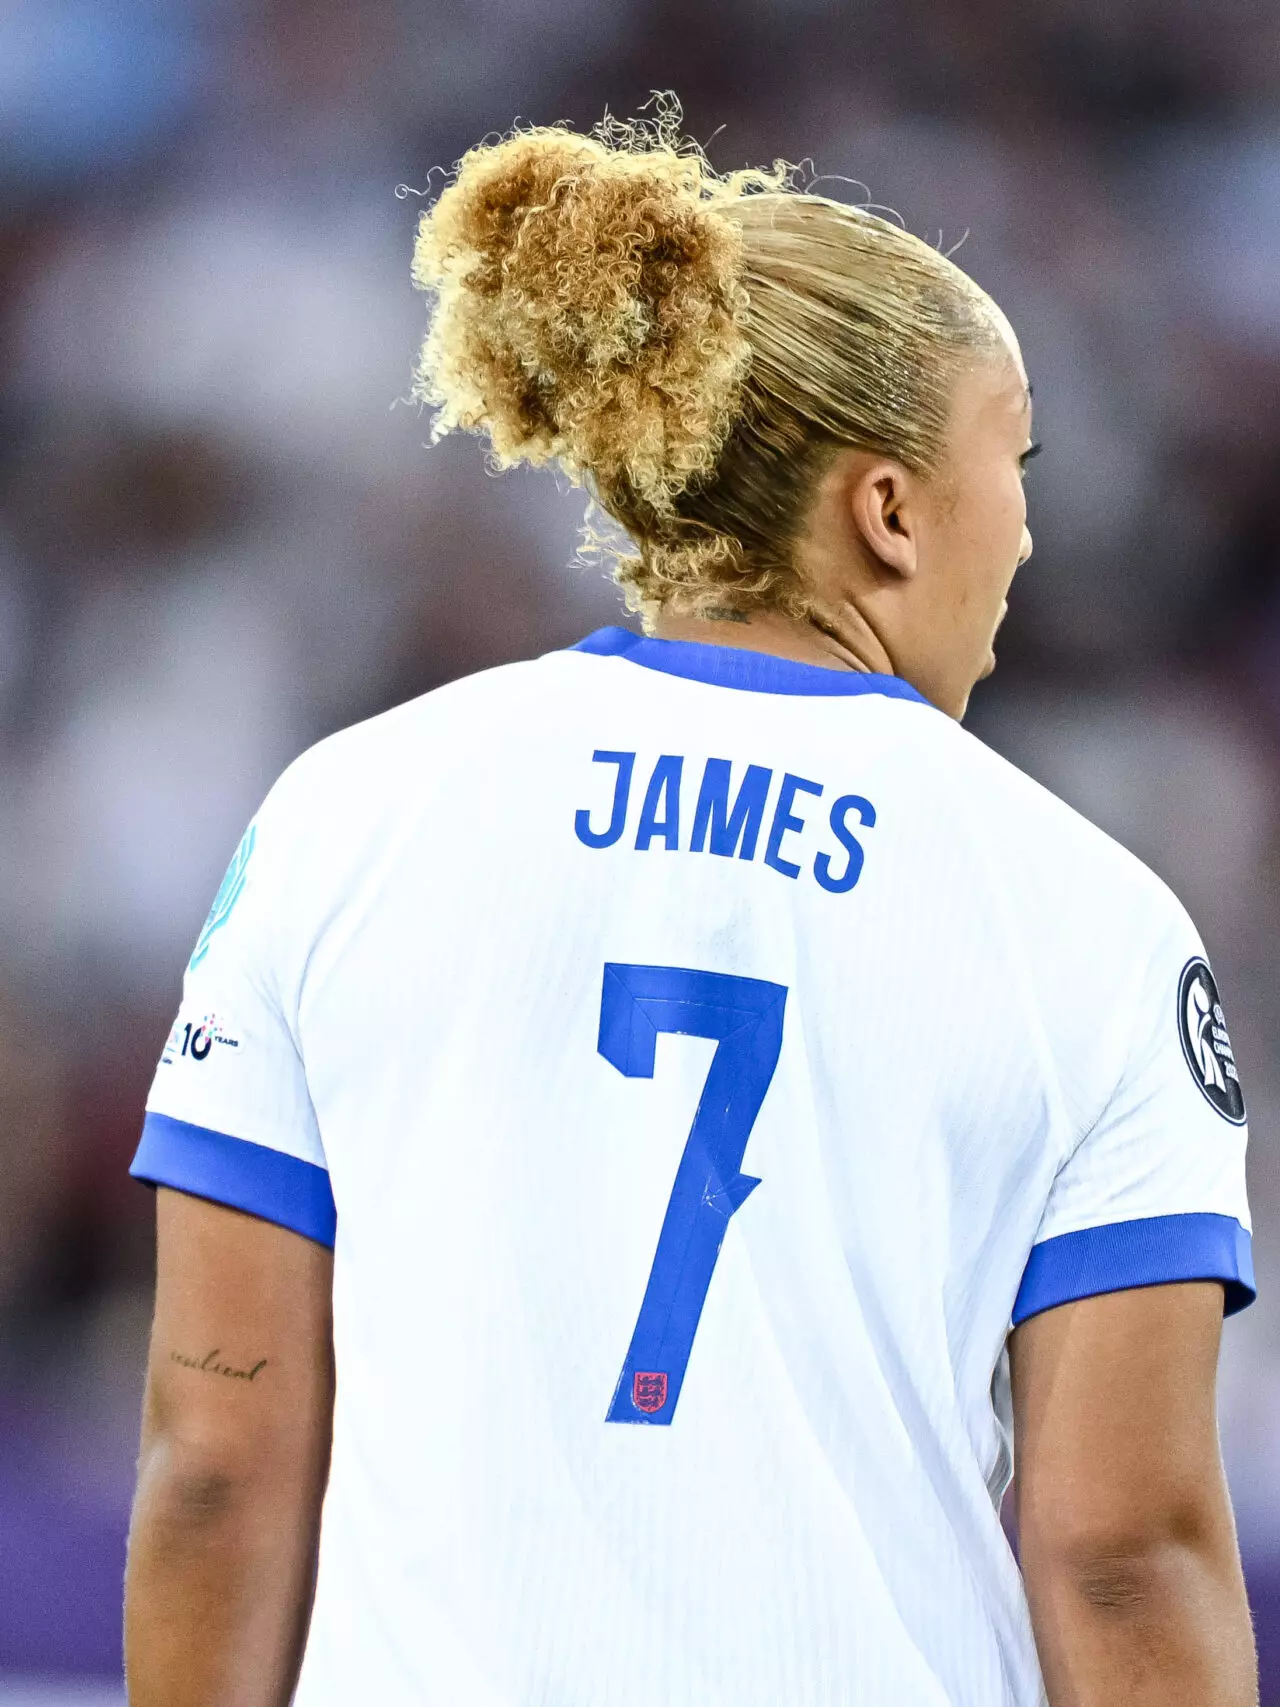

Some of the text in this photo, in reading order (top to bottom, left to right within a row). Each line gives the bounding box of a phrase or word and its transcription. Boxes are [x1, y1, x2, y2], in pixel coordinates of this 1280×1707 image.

[574, 750, 877, 893] JAMES
[182, 1022, 239, 1060] 10 YEARS
[597, 963, 788, 1426] 7
